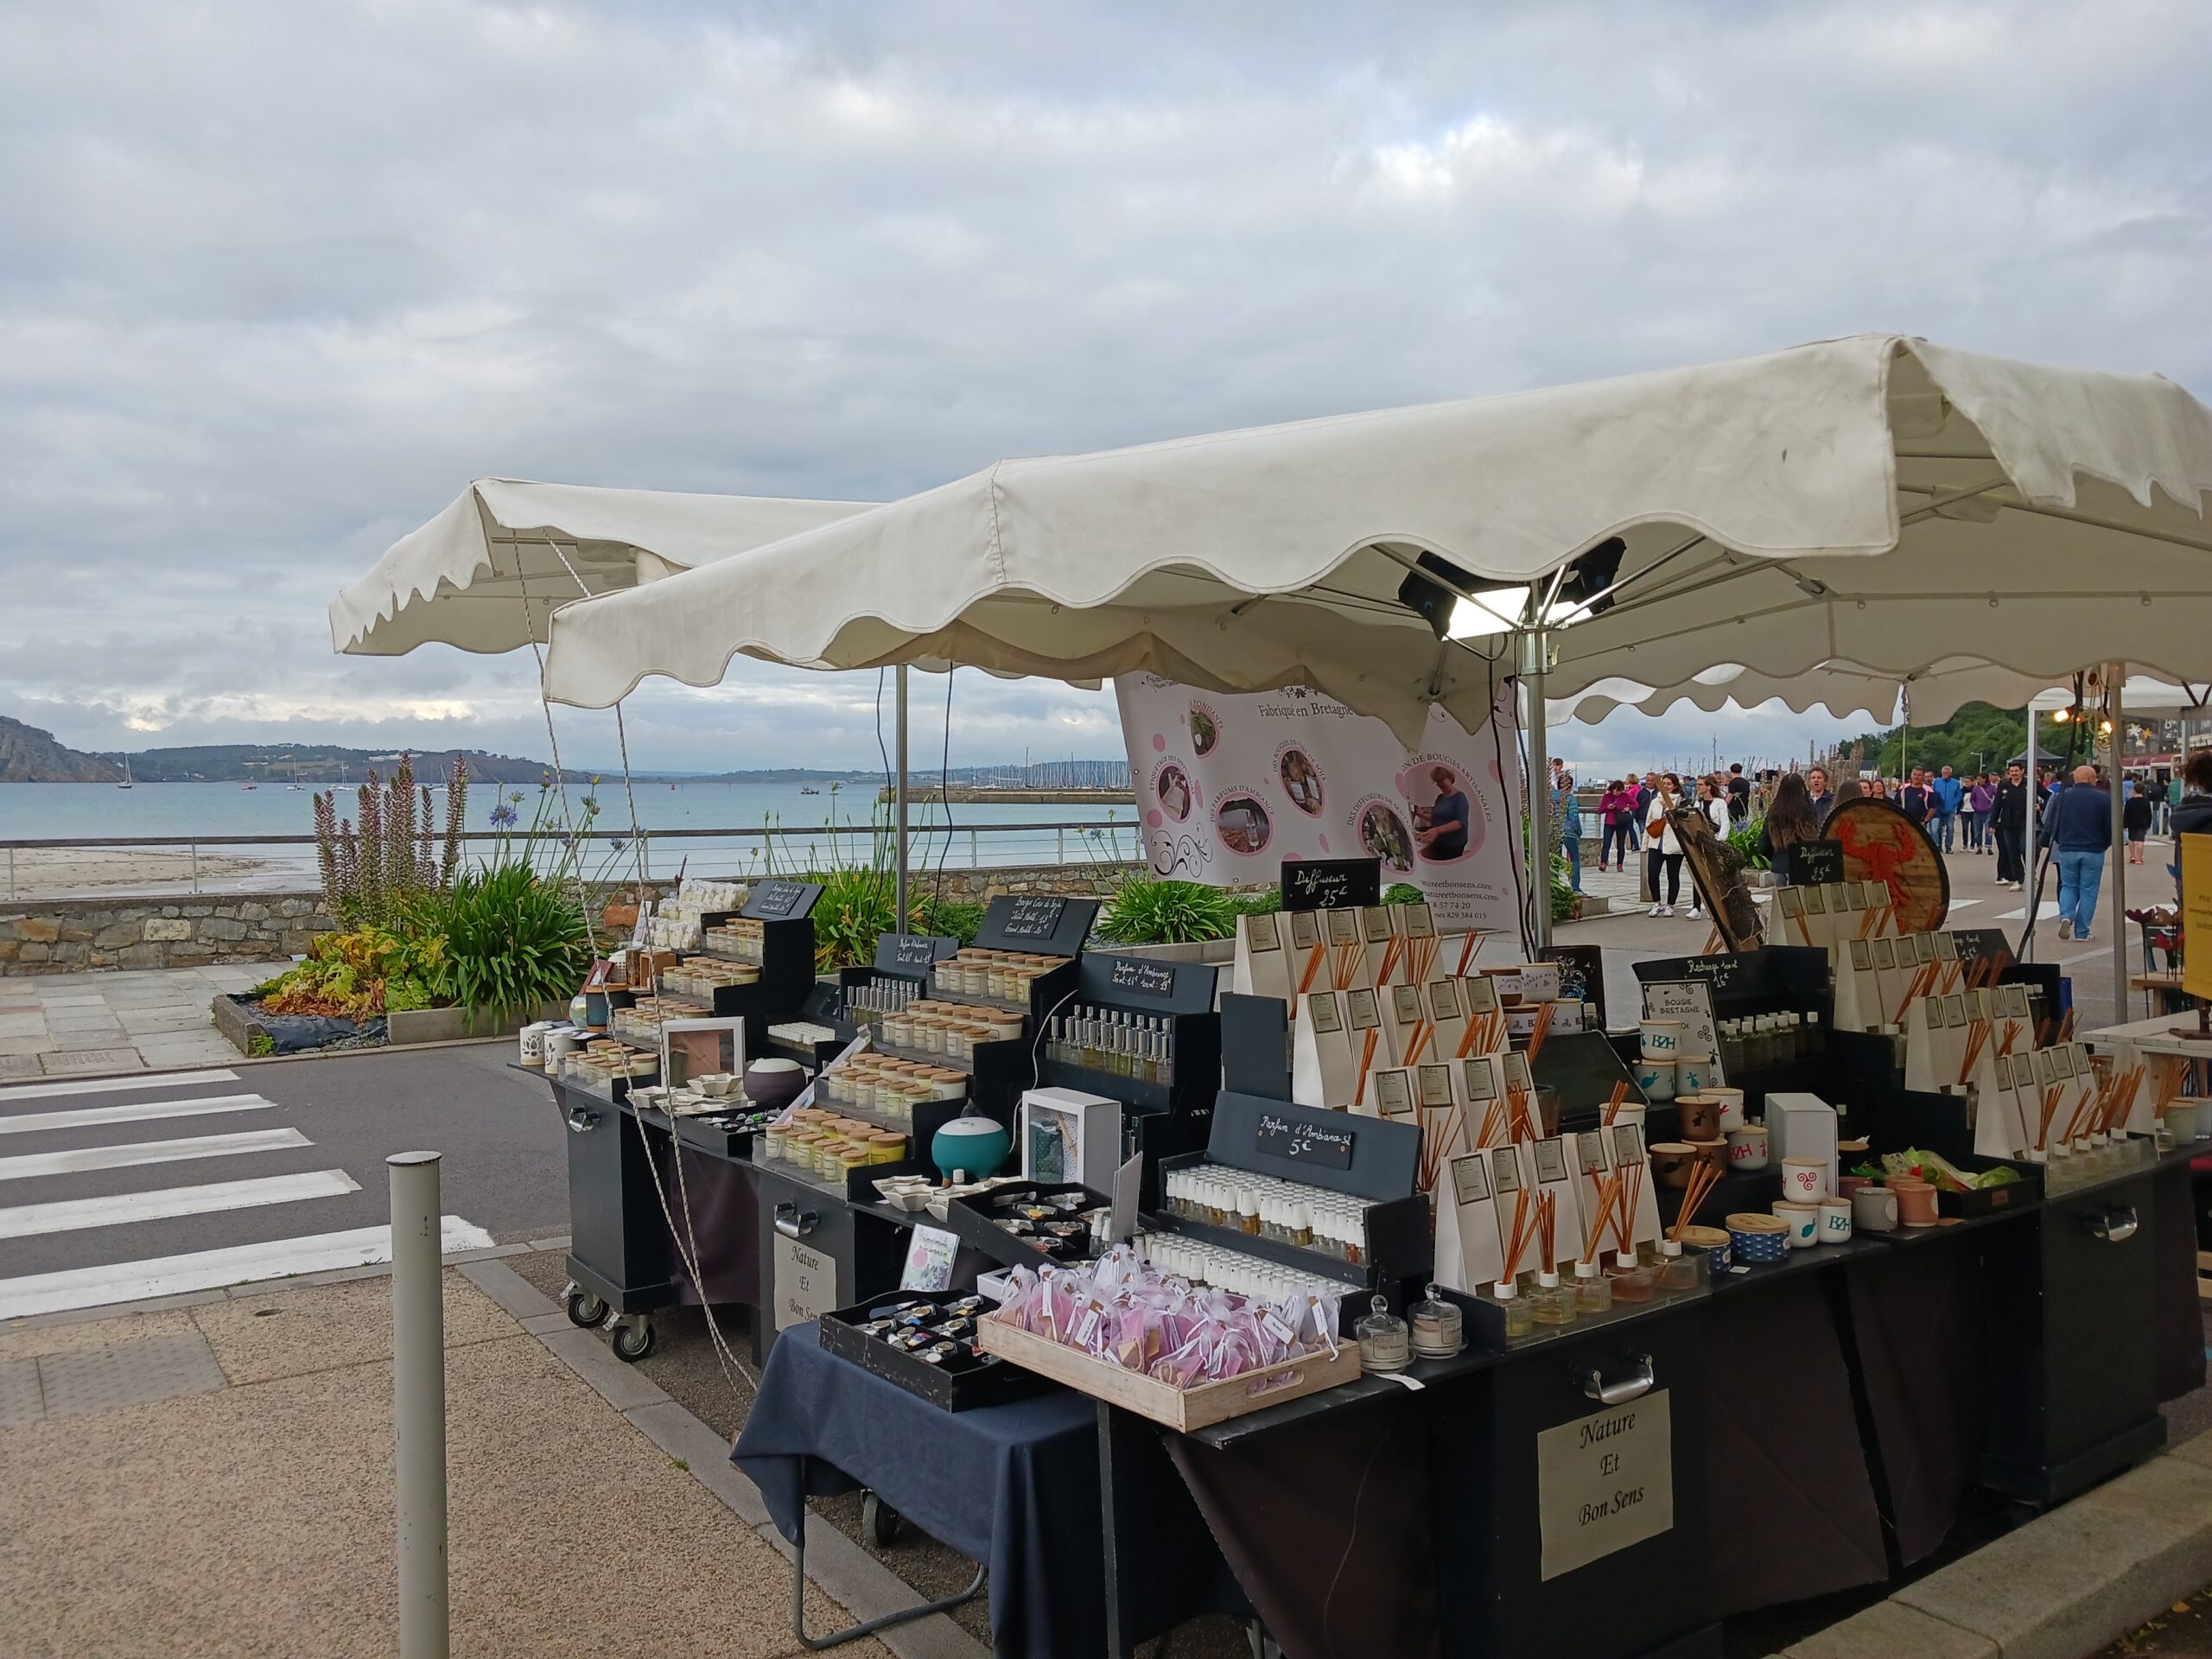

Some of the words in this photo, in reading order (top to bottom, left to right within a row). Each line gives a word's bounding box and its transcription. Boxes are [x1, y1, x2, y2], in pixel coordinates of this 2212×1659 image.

[1296, 709, 1309, 717] en
[1311, 702, 1354, 719] Bretagne
[1412, 754, 1427, 766] DE
[1427, 753, 1460, 770] BOUGIES
[1460, 768, 1493, 823] ARTISANALES
[1212, 785, 1238, 809] PARFUMS
[1239, 785, 1274, 816] D'AMBIANCE
[1347, 810, 1357, 827] DES
[1294, 868, 1348, 895] Diffuseur
[1319, 886, 1349, 907] 25€
[1138, 963, 1169, 979] d'Ambiance
[1659, 1006, 1701, 1014] BRETAGNE
[1664, 998, 1693, 1007] BOUGIE
[1651, 1033, 1677, 1051] BZH
[1260, 1116, 1288, 1137] Parfum
[1288, 1139, 1312, 1155] 5€
[791, 1245, 819, 1271] Nature
[799, 1275, 810, 1292] Et
[789, 1298, 804, 1318] Bon
[1580, 1412, 1637, 1449] Nature
[1599, 1453, 1621, 1477] Et
[1578, 1502, 1609, 1527] Bon
[1611, 1485, 1645, 1514] Sens
